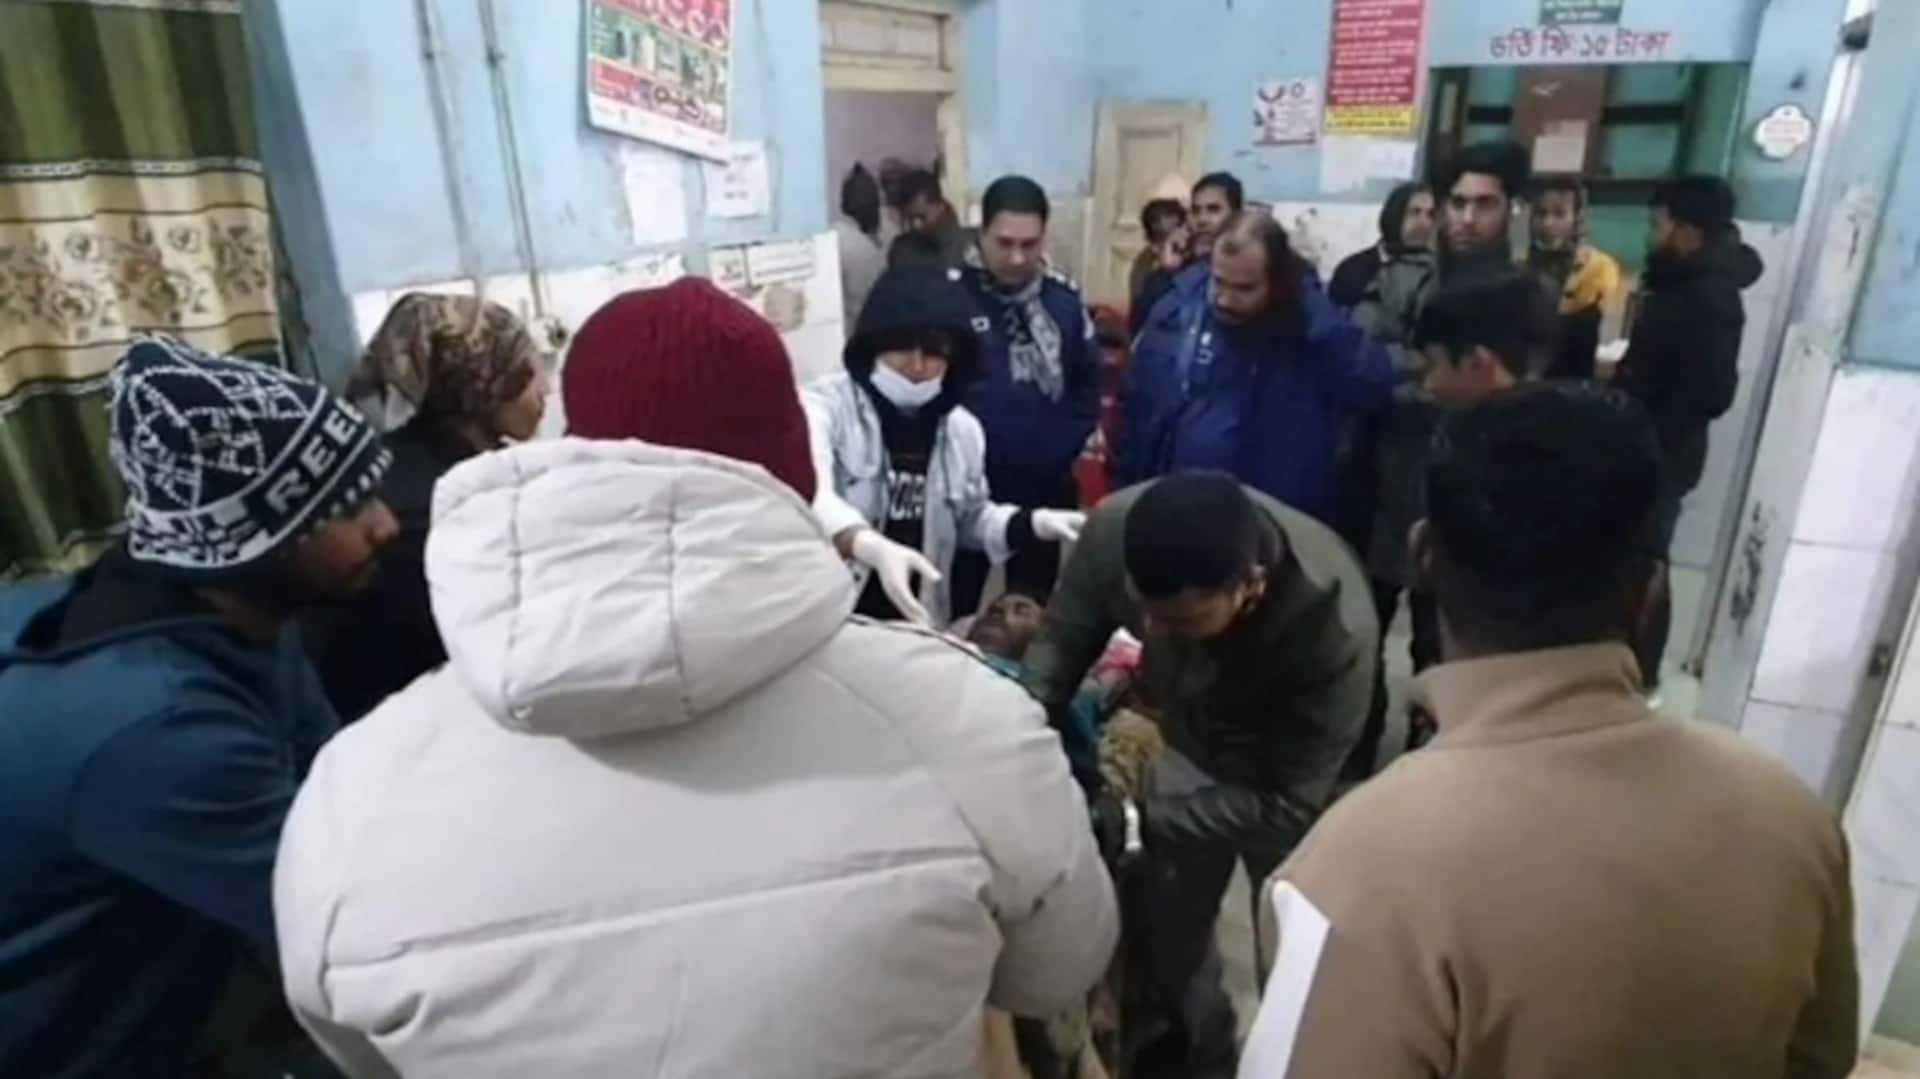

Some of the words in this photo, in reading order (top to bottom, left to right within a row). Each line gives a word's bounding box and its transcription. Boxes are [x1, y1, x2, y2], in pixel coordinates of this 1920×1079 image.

[1490, 27, 1535, 58] ভর্তি
[1579, 34, 1609, 57] ১৫
[1615, 27, 1670, 57] টাকা
